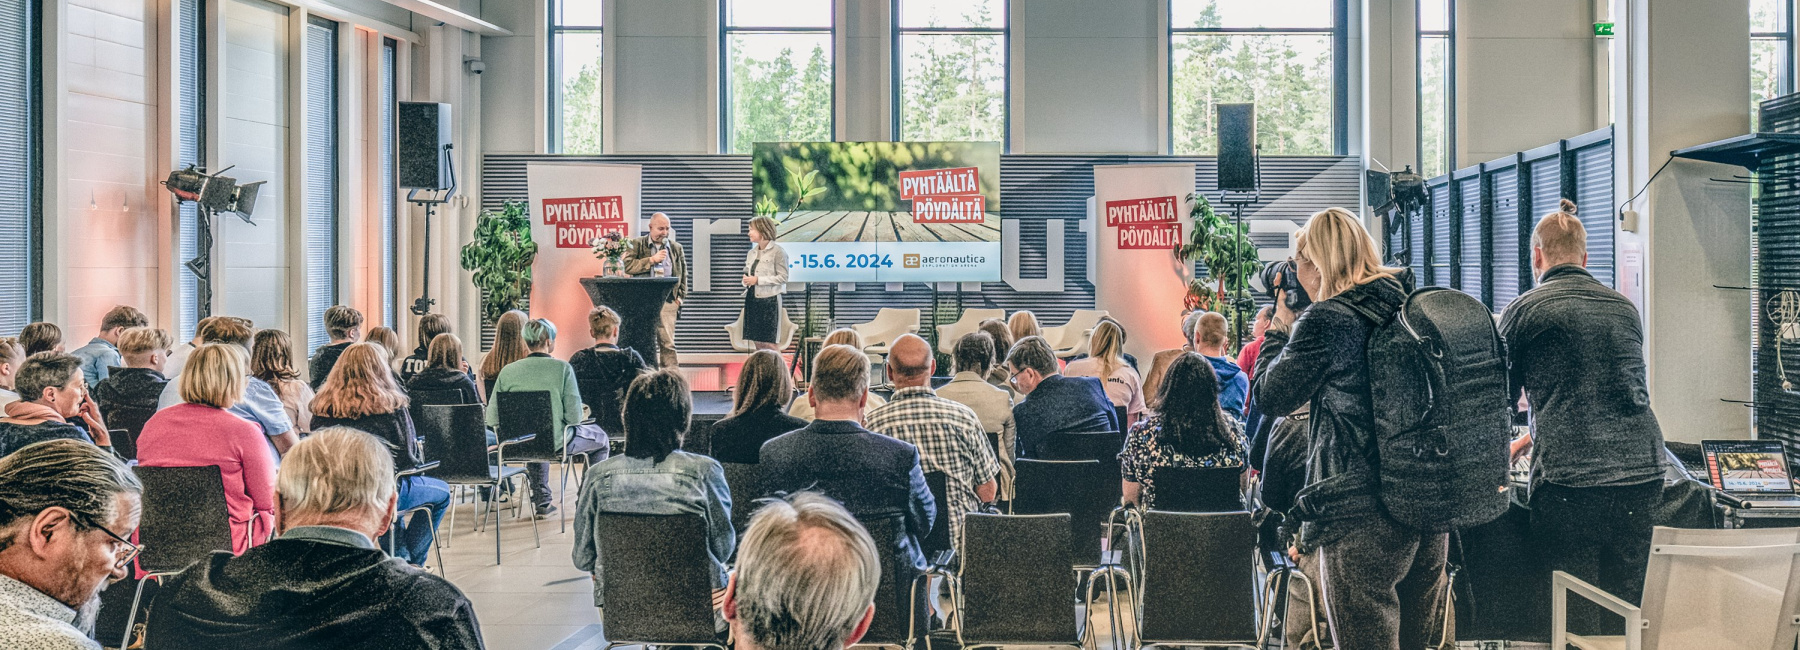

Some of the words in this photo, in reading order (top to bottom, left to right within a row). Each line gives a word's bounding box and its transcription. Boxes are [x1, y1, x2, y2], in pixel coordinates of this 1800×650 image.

[903, 169, 977, 196] PYHTÄÄLTÄ
[545, 198, 621, 222] PYHTÄÄLTÄ
[915, 197, 982, 220] PÖYDÄLTÄ
[1108, 198, 1175, 224] PYHTÄÄLTÄ
[1120, 225, 1180, 247] PÖYDÄLTÄ
[789, 254, 840, 268] .-15.6.
[845, 254, 893, 268] 2024
[922, 254, 986, 264] aeronautica
